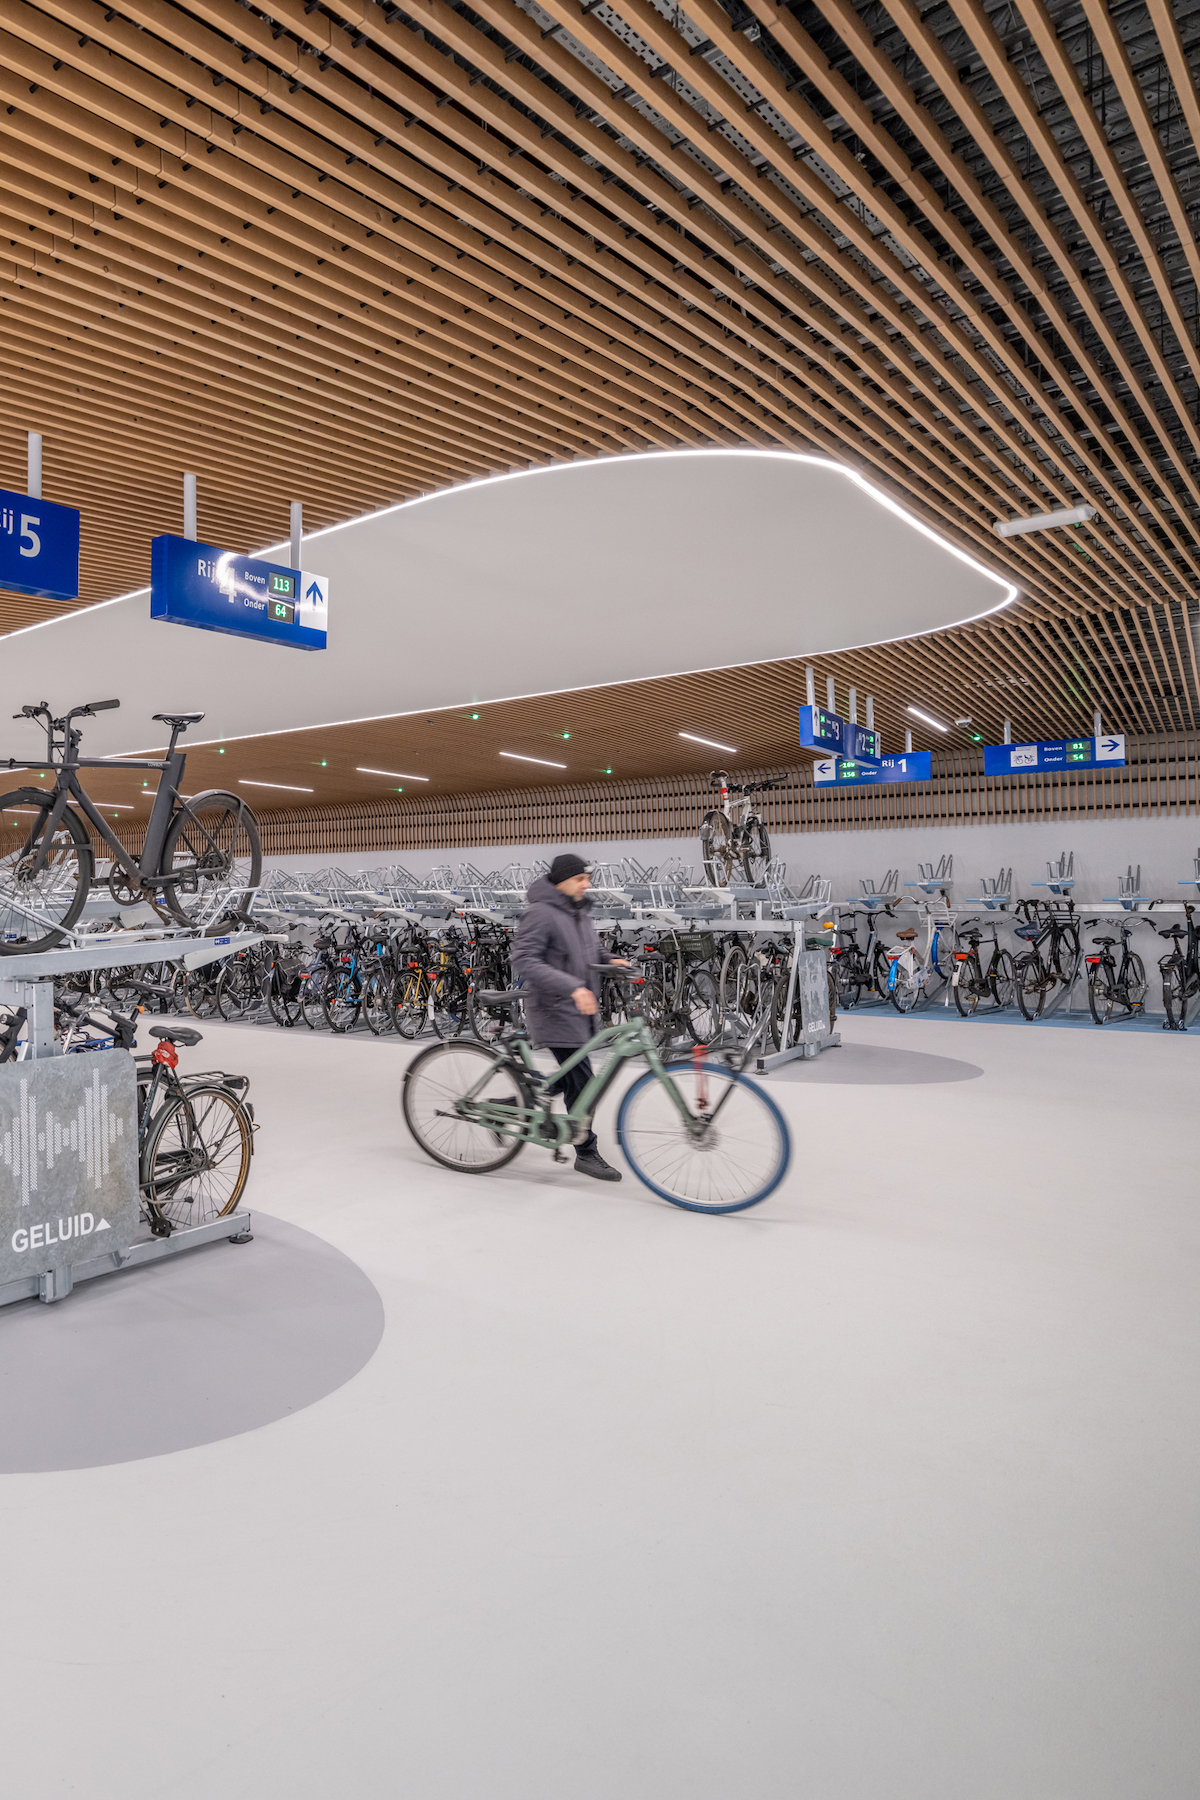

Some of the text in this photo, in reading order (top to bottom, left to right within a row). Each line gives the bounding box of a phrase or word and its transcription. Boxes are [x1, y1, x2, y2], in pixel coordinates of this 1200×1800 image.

[19, 514, 42, 557] 5
[197, 559, 237, 603] Rij 4
[244, 572, 266, 585] Boven
[273, 577, 290, 592] 113
[244, 598, 265, 611] Onder
[275, 604, 287, 618] 64
[836, 722, 840, 740] 3
[882, 758, 906, 772] Rij 1
[11, 1212, 95, 1253] GELUID
